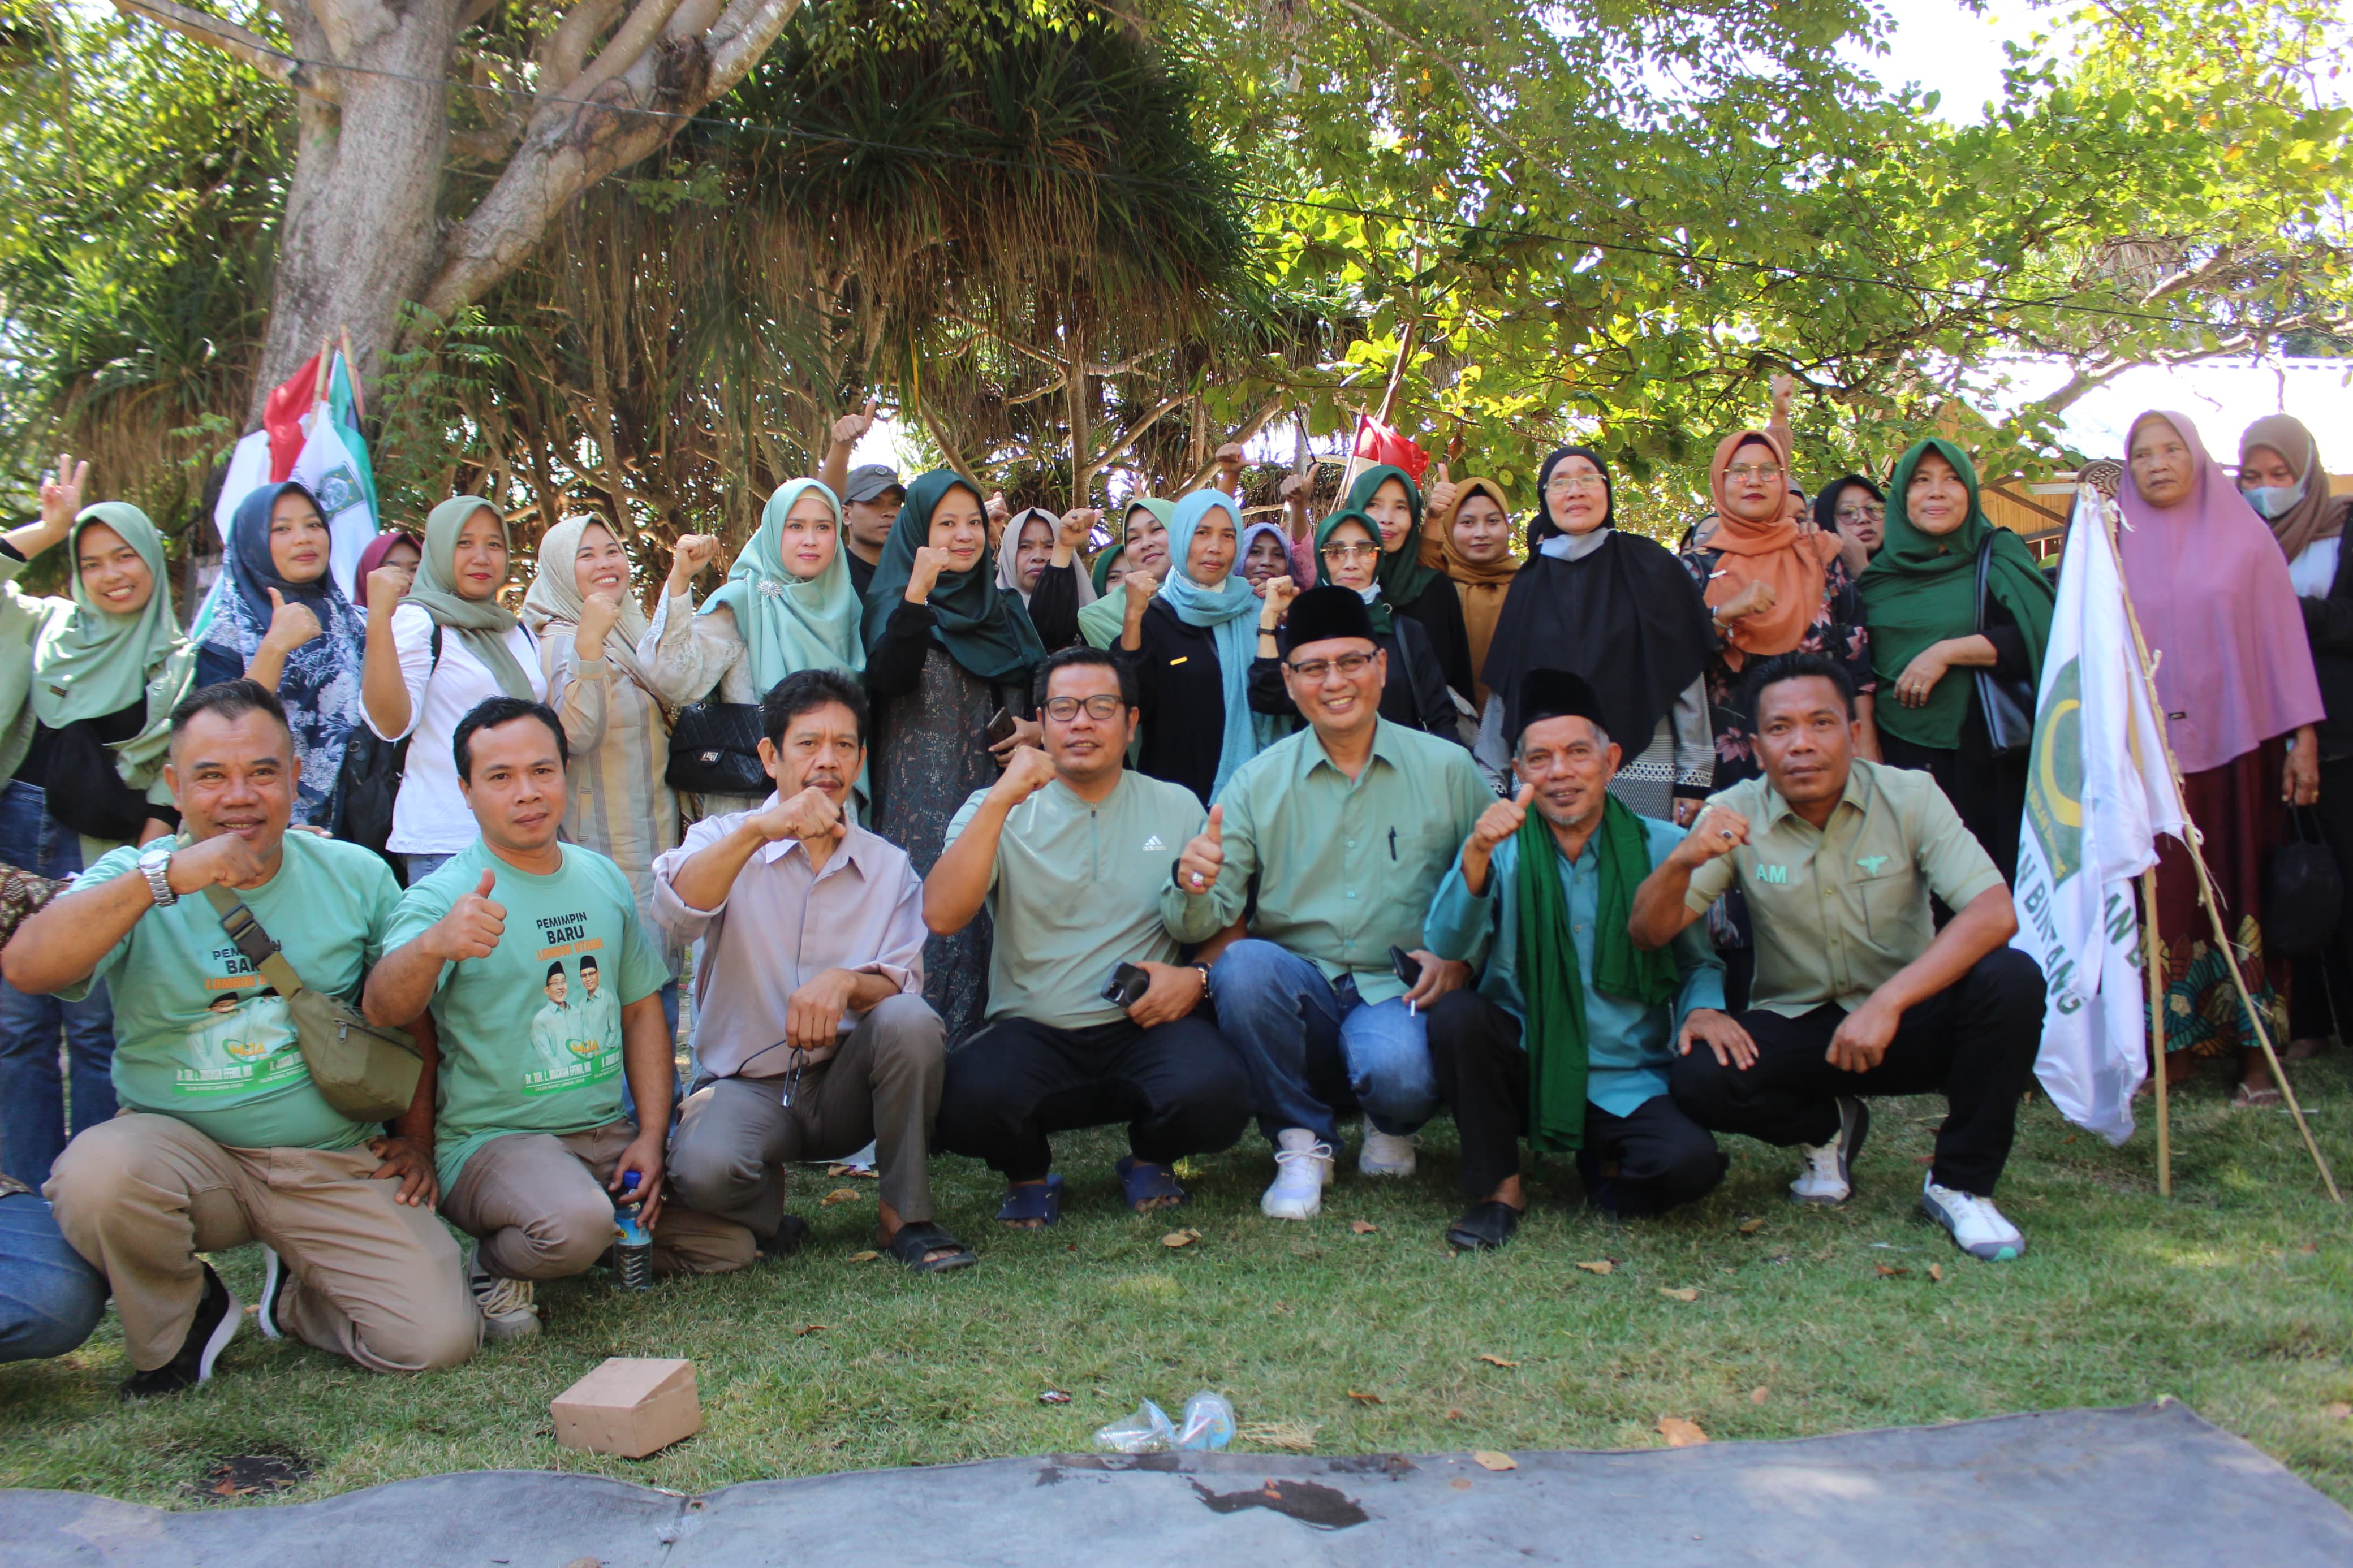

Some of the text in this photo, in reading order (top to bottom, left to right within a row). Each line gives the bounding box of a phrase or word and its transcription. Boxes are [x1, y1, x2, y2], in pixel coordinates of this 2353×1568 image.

[1756, 863, 1787, 884] AM
[536, 911, 587, 929] PEMIMPIN
[546, 925, 584, 944] BARU
[536, 937, 604, 961] LOMBOK UTARA
[2024, 880, 2082, 1015] BINTANG
[205, 975, 257, 990] LOMBOK
